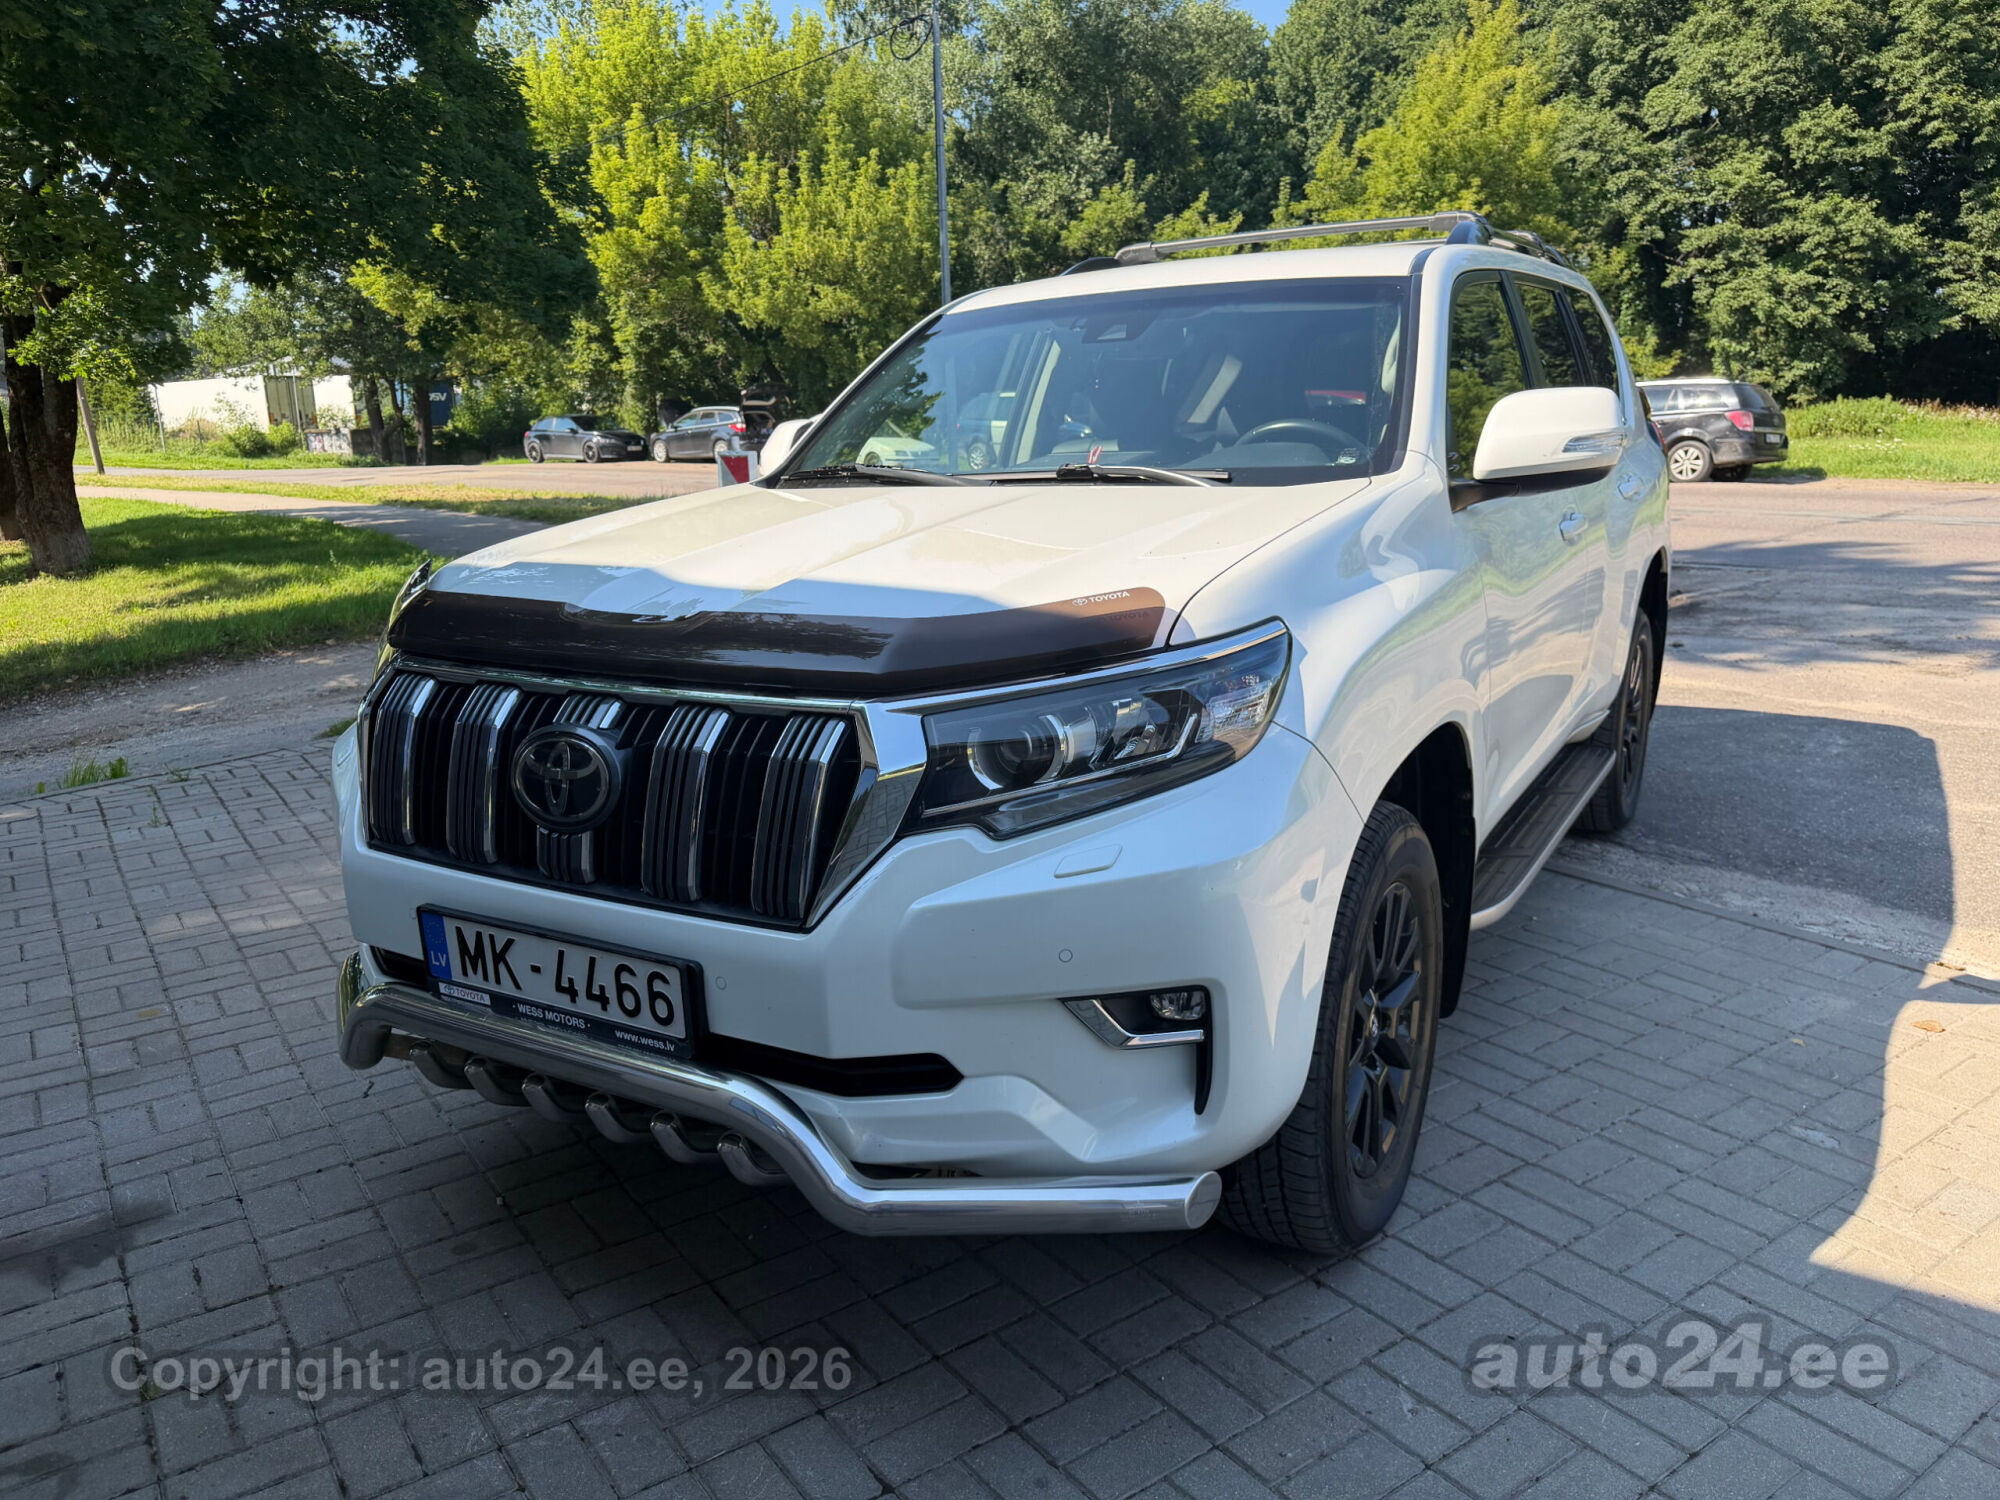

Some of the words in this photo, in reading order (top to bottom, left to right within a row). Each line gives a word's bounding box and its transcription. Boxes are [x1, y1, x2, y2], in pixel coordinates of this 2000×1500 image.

[1088, 591, 1130, 603] TOYOTA
[430, 951, 447, 968] LV
[455, 926, 675, 1027] MK-4466
[455, 987, 486, 1002] TOYOTA
[517, 1003, 543, 1018] WESS
[545, 1009, 585, 1029] MOTORS
[614, 1030, 675, 1052] www.wess.lv
